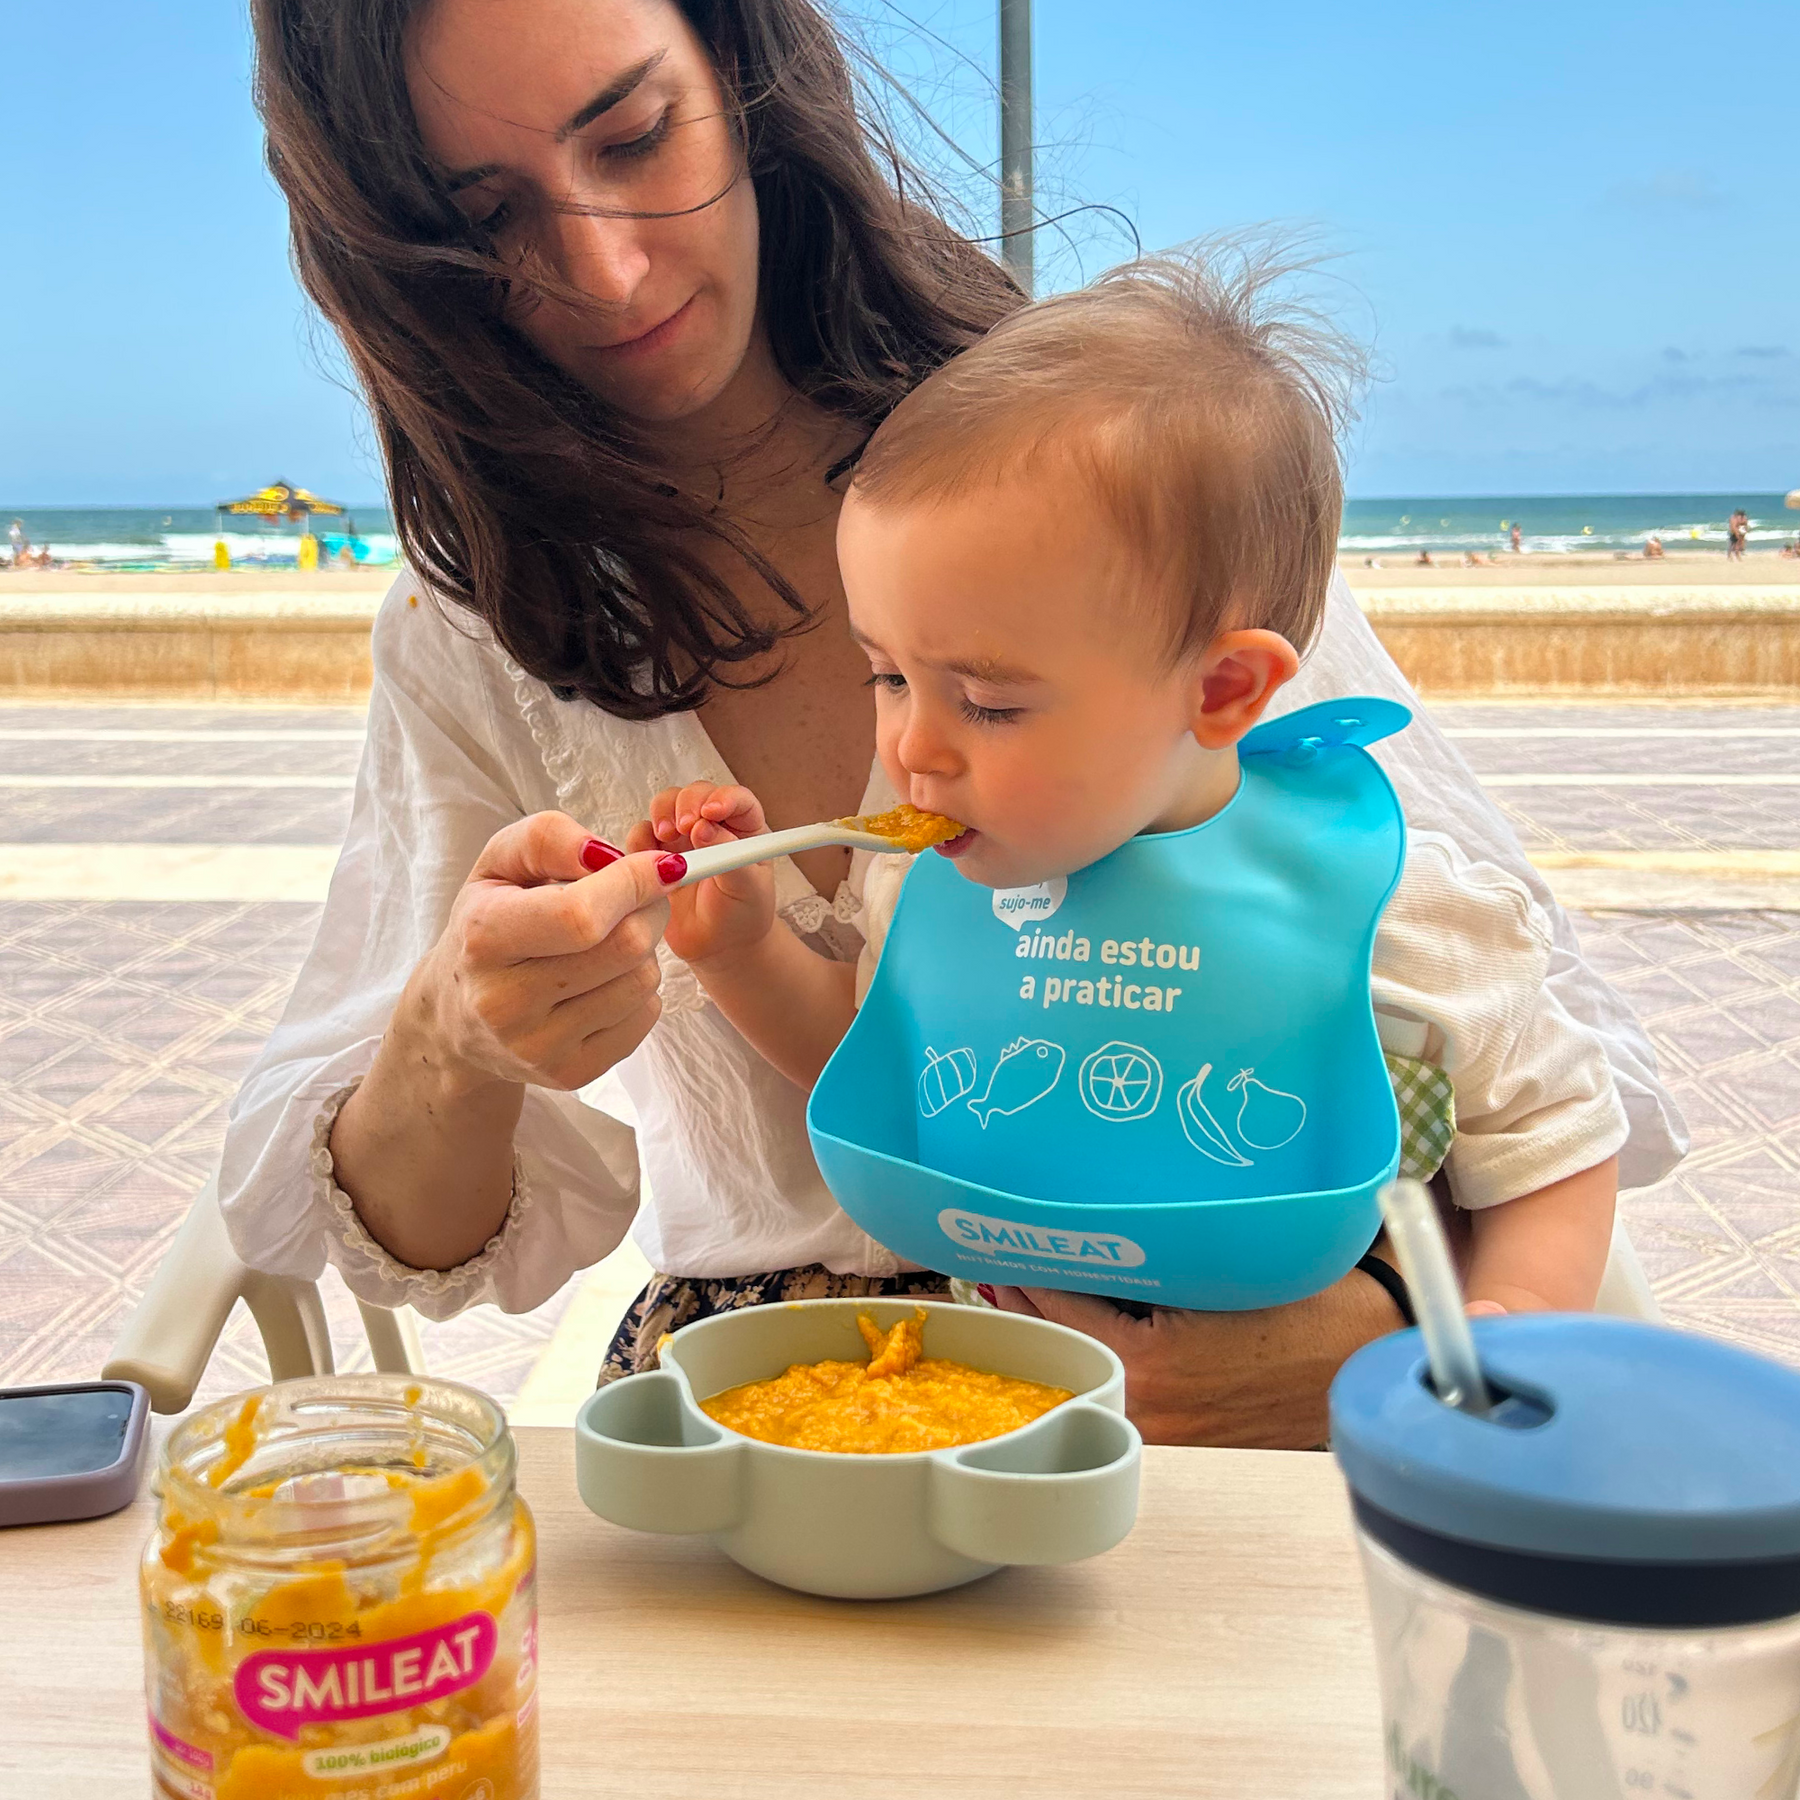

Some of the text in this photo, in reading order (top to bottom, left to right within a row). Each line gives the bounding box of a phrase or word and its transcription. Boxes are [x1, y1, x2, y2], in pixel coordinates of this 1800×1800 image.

[999, 894, 1052, 913] sujo-me
[1015, 928, 1201, 971] ainda estou
[1019, 975, 1182, 1012] a praticar
[954, 1217, 1122, 1262] SMILEAT
[956, 1253, 1162, 1288] NUTRIMOS COM HONESTIDADE
[240, 1617, 363, 1640] 06-2024
[258, 1626, 481, 1712] SMILEAT
[315, 1735, 441, 1771] 100% biológico
[426, 1760, 467, 1791] peru
